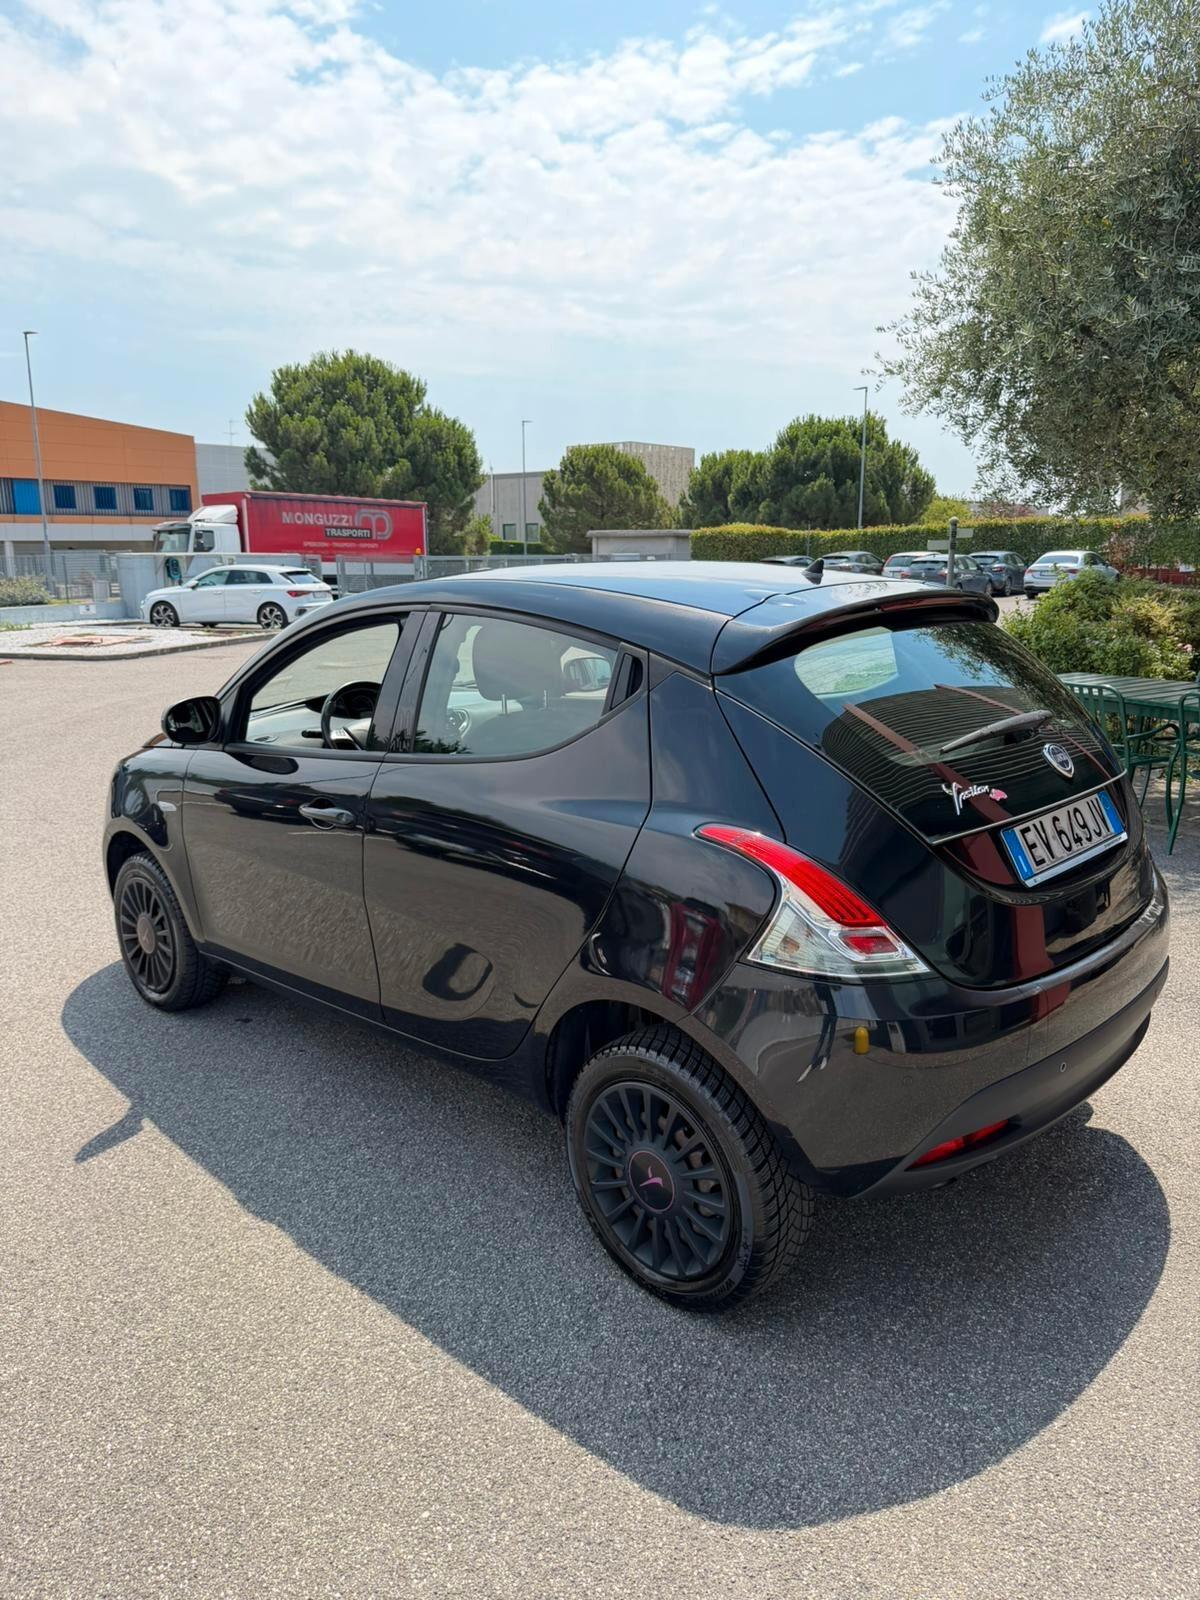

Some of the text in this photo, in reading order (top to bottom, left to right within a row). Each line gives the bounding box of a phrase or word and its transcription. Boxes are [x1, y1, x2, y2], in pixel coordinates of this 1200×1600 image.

[281, 511, 353, 527] MONGUZZI
[325, 527, 370, 538] TRASPORTI
[941, 781, 990, 816] Ypsilon
[1020, 797, 1110, 867] EV 649 JV
